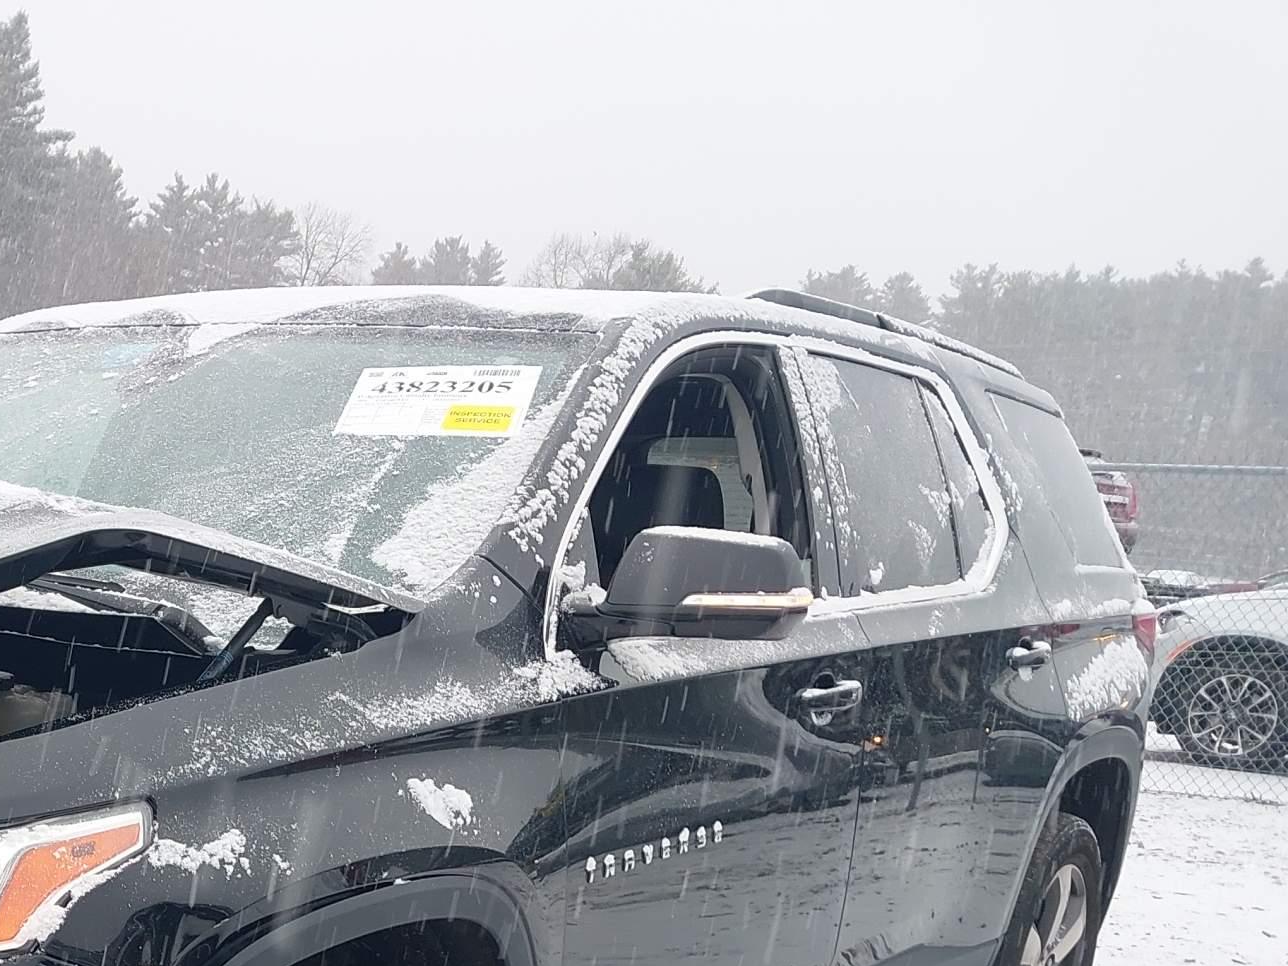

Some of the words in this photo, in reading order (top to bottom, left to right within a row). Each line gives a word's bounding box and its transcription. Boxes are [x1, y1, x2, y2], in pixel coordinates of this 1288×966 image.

[371, 380, 513, 394] 43823205
[449, 410, 512, 418] INSPECTION
[455, 417, 501, 425] SERVICE
